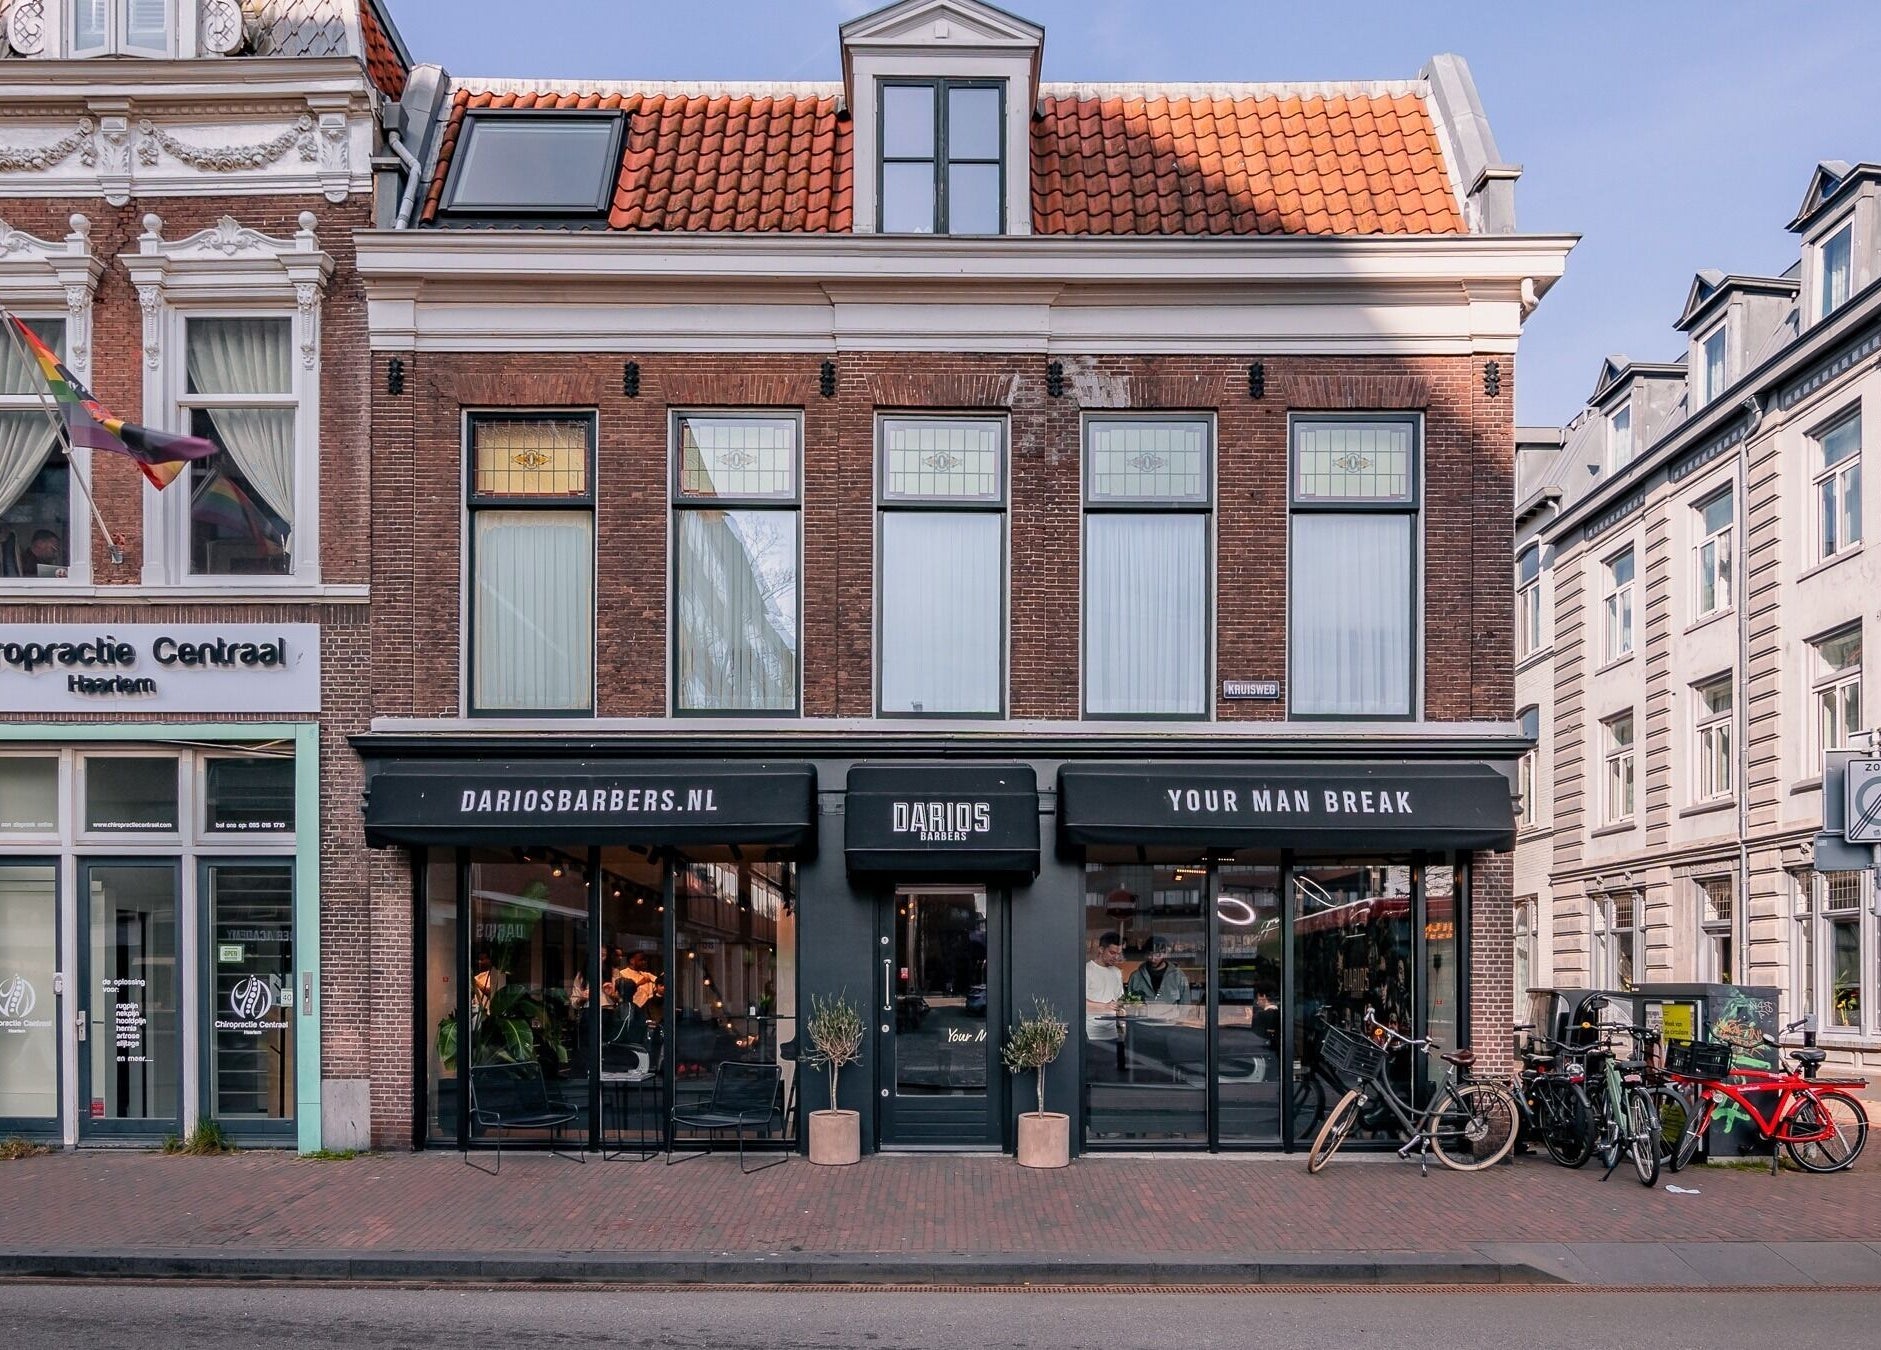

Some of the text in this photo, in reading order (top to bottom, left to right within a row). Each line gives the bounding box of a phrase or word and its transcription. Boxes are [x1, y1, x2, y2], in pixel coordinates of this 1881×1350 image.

[153, 636, 286, 666] Centraal
[68, 674, 156, 693] Haarlem
[1228, 684, 1275, 695] KRUISWEG
[460, 788, 718, 812] DARIOSBARBERS.NL
[1167, 789, 1413, 813] YOUR MAN BREAK
[893, 802, 990, 832] DARIOS
[920, 831, 967, 841] BARBERS
[113, 978, 146, 987] oplossing
[116, 1018, 147, 1026] hoofdpijn
[214, 1020, 289, 1029] Chiropractie Centraal
[948, 1027, 972, 1043] Your
